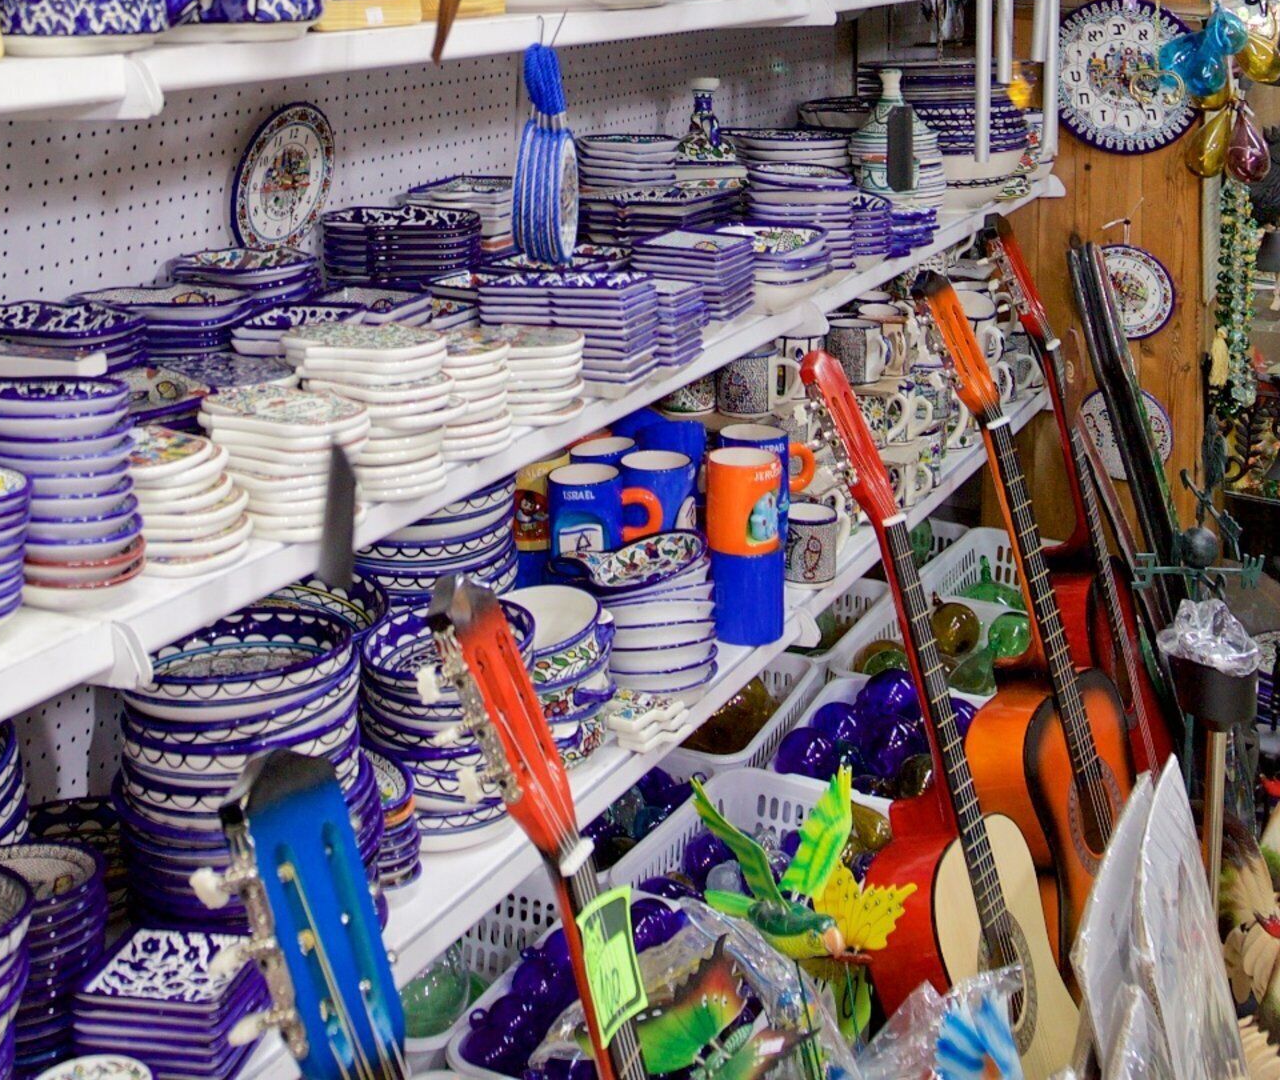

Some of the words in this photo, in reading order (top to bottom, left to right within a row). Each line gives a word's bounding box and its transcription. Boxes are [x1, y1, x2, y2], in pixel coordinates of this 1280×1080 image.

[1113, 23, 1126, 35] יב
[1138, 29, 1149, 41] א
[1087, 29, 1104, 42] יא
[1070, 70, 1081, 82] ט
[1078, 92, 1090, 105] ח
[1099, 109, 1107, 122] ז
[1146, 107, 1157, 121] ה
[1124, 114, 1131, 127] ו
[289, 127, 299, 139] 12
[274, 135, 283, 147] 11
[312, 148, 319, 160] 2
[259, 155, 269, 168] 10
[252, 205, 259, 217] 8
[562, 489, 596, 501] ISRAEL
